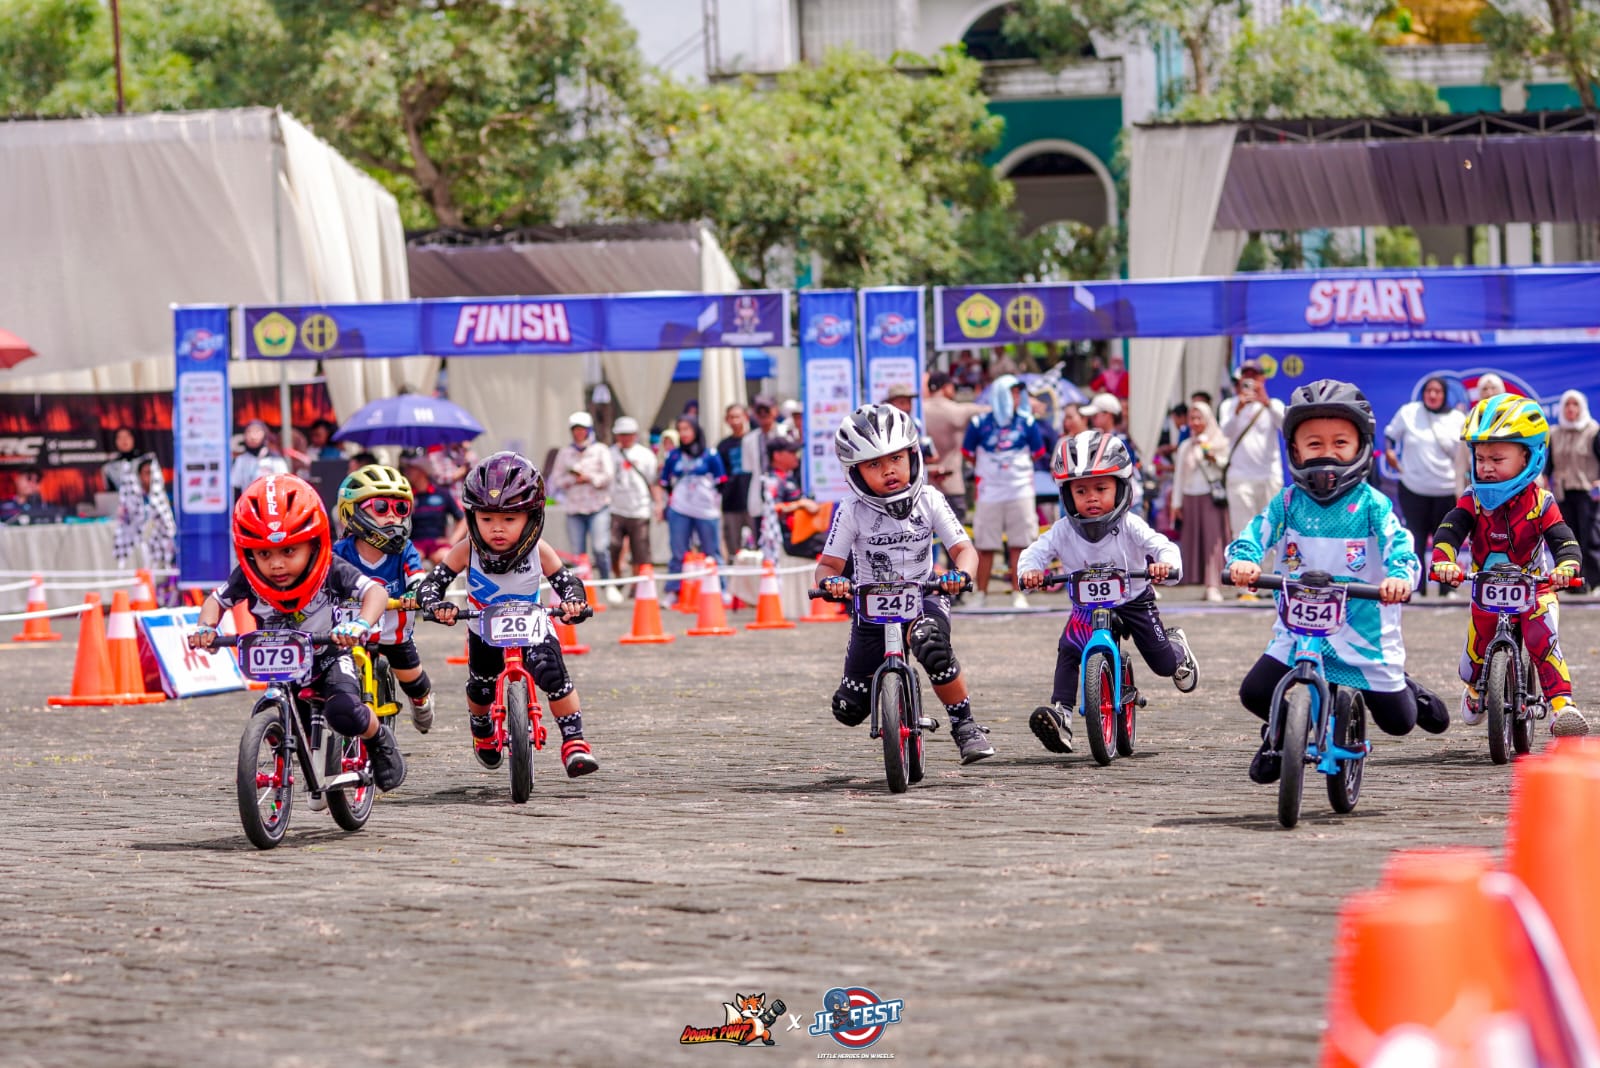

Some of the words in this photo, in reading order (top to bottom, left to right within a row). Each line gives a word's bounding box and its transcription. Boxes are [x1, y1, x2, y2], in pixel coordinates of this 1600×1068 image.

[1306, 279, 1426, 326] START
[454, 303, 571, 345] FINISH
[828, 511, 843, 547] MANTRA
[1088, 582, 1111, 597] 98
[1486, 585, 1522, 601] 610
[877, 597, 902, 611] 24
[904, 593, 916, 613] B
[1292, 603, 1332, 622] 454
[502, 617, 527, 632] 26
[531, 616, 541, 637] A
[253, 648, 295, 666] 079
